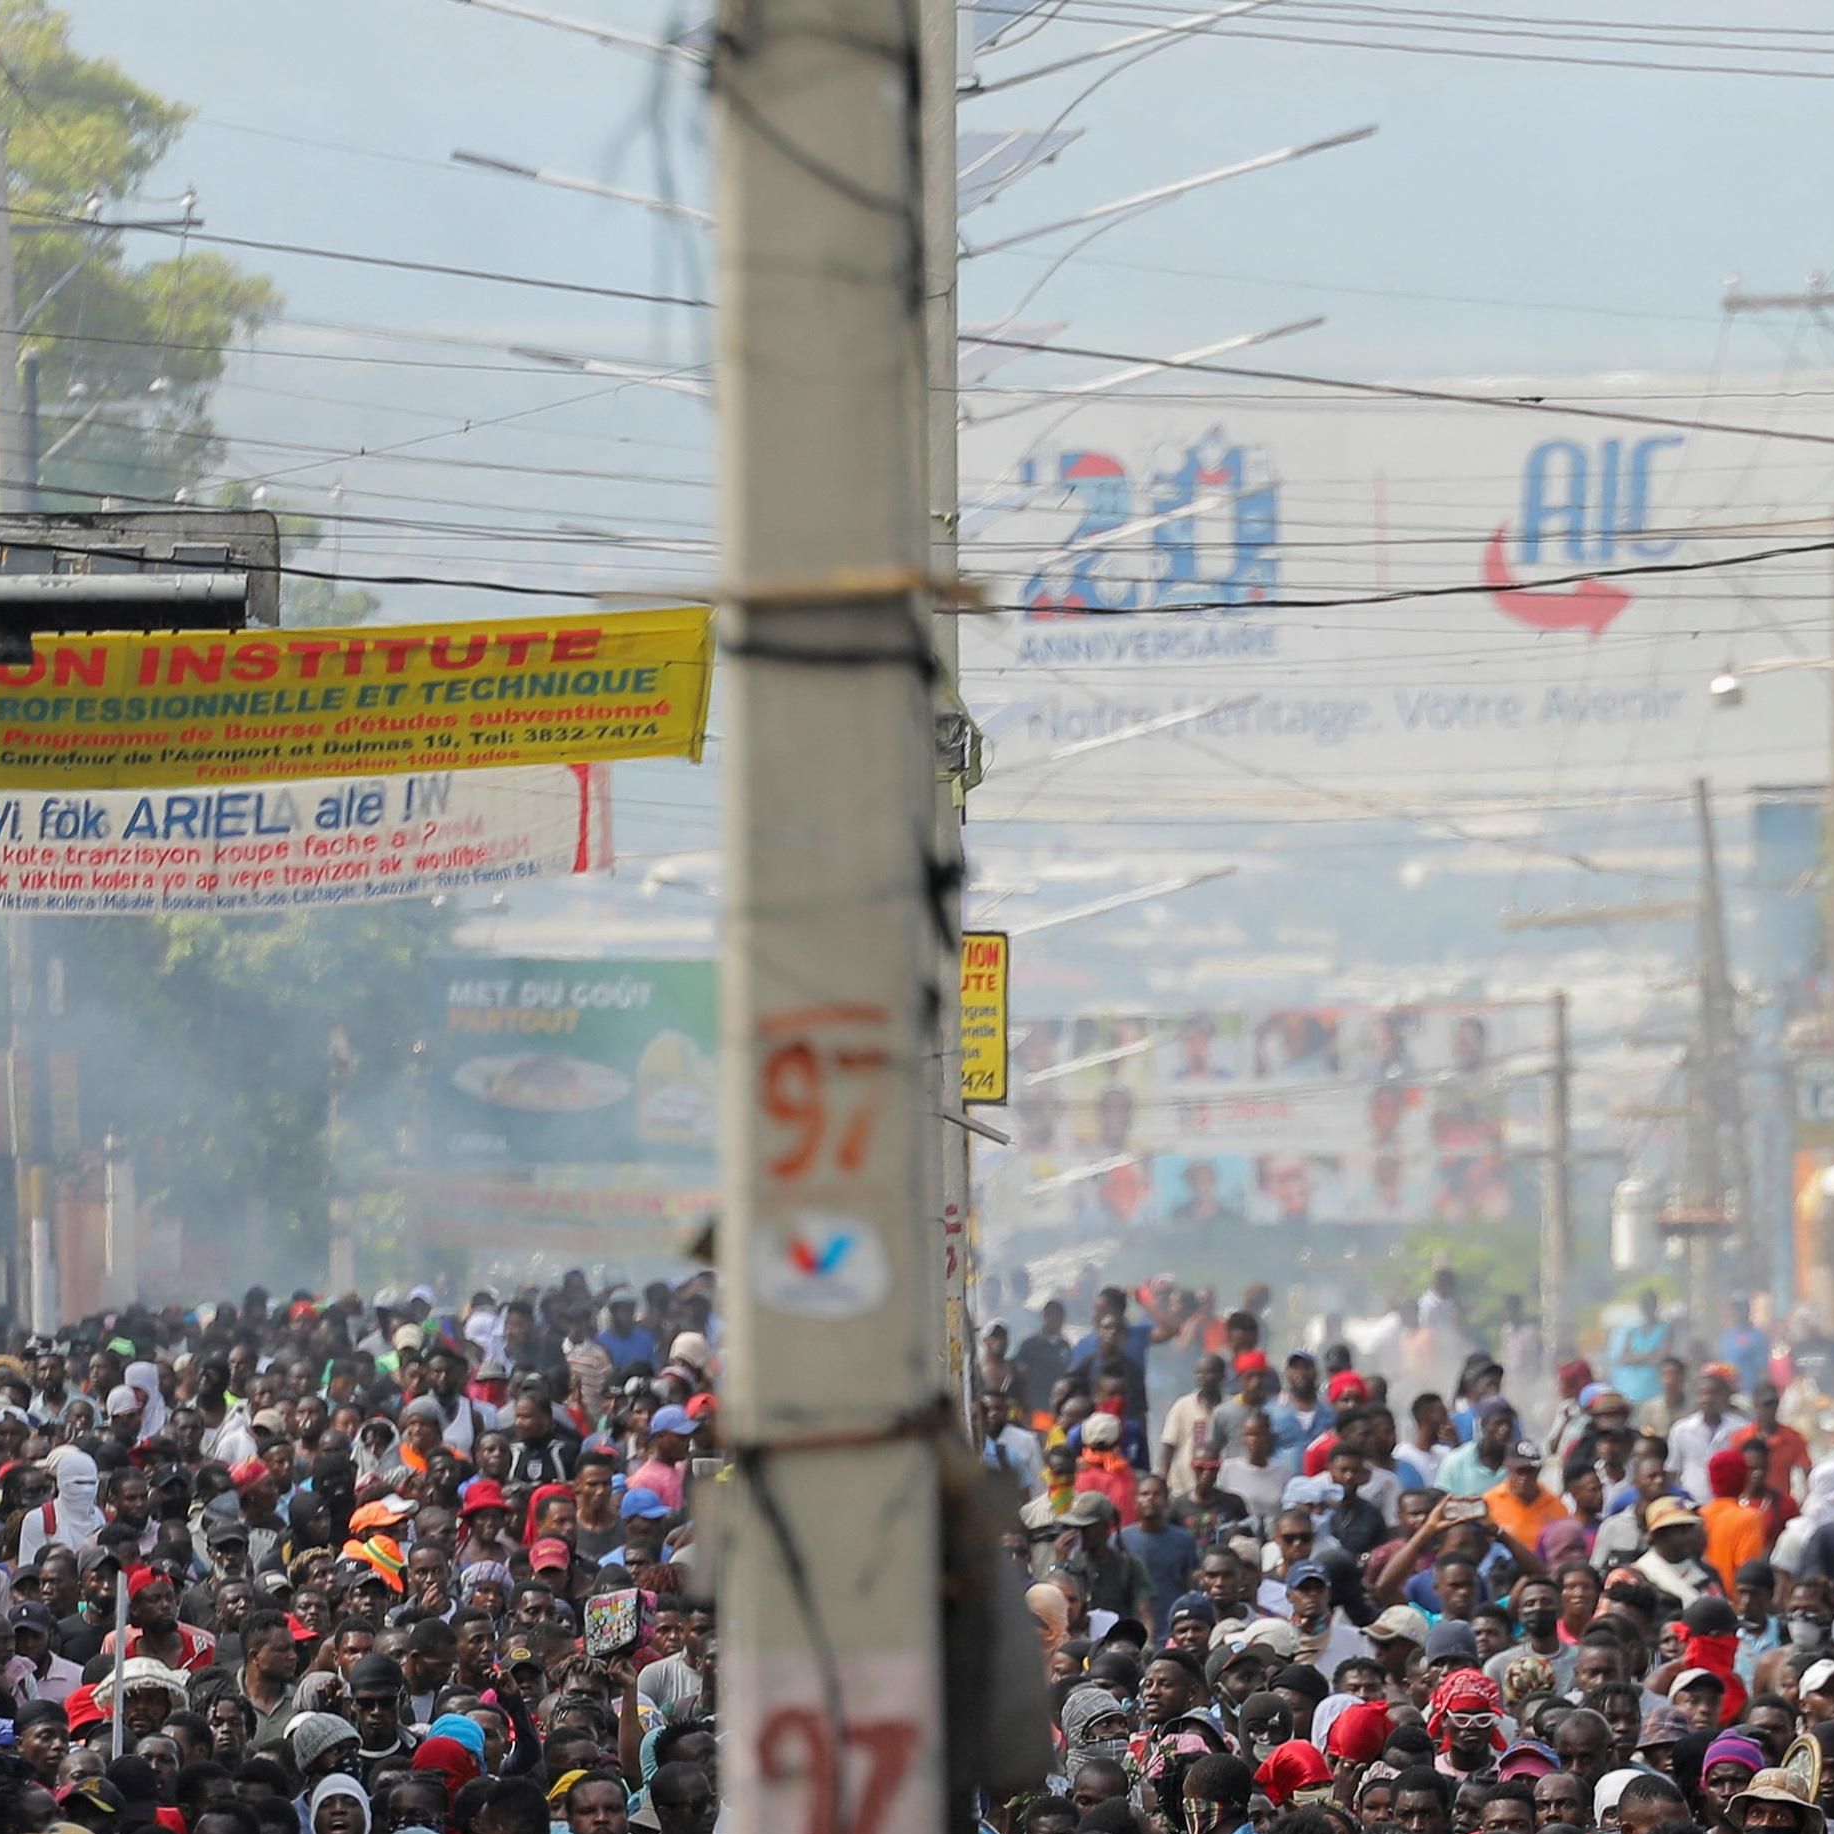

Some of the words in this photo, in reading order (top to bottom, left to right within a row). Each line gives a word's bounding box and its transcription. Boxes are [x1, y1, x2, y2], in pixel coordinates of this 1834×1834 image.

[138, 628, 603, 687] INSTITUTE
[355, 682, 409, 708] ET
[420, 666, 659, 705] TECHNIQUE
[2, 726, 170, 751] Programme
[179, 726, 214, 744] de
[223, 721, 326, 741] Bourse
[469, 698, 672, 727] subventionné
[0, 751, 116, 769] Carrefour
[123, 750, 152, 765] de
[289, 742, 315, 757] et
[322, 737, 414, 756] Delmas
[121, 791, 291, 841] ARIEL
[314, 784, 385, 831] ale
[3, 843, 56, 866] kote
[66, 840, 200, 869] tranzisyon
[214, 840, 290, 864] koupe
[303, 832, 378, 857] fache
[18, 866, 84, 891] viktim
[92, 868, 154, 891] kolera
[162, 871, 186, 895] yo
[196, 872, 219, 893] ap
[229, 866, 275, 891] veye
[283, 859, 370, 887] trayizon
[378, 853, 403, 877] ak
[962, 942, 1000, 969] ION
